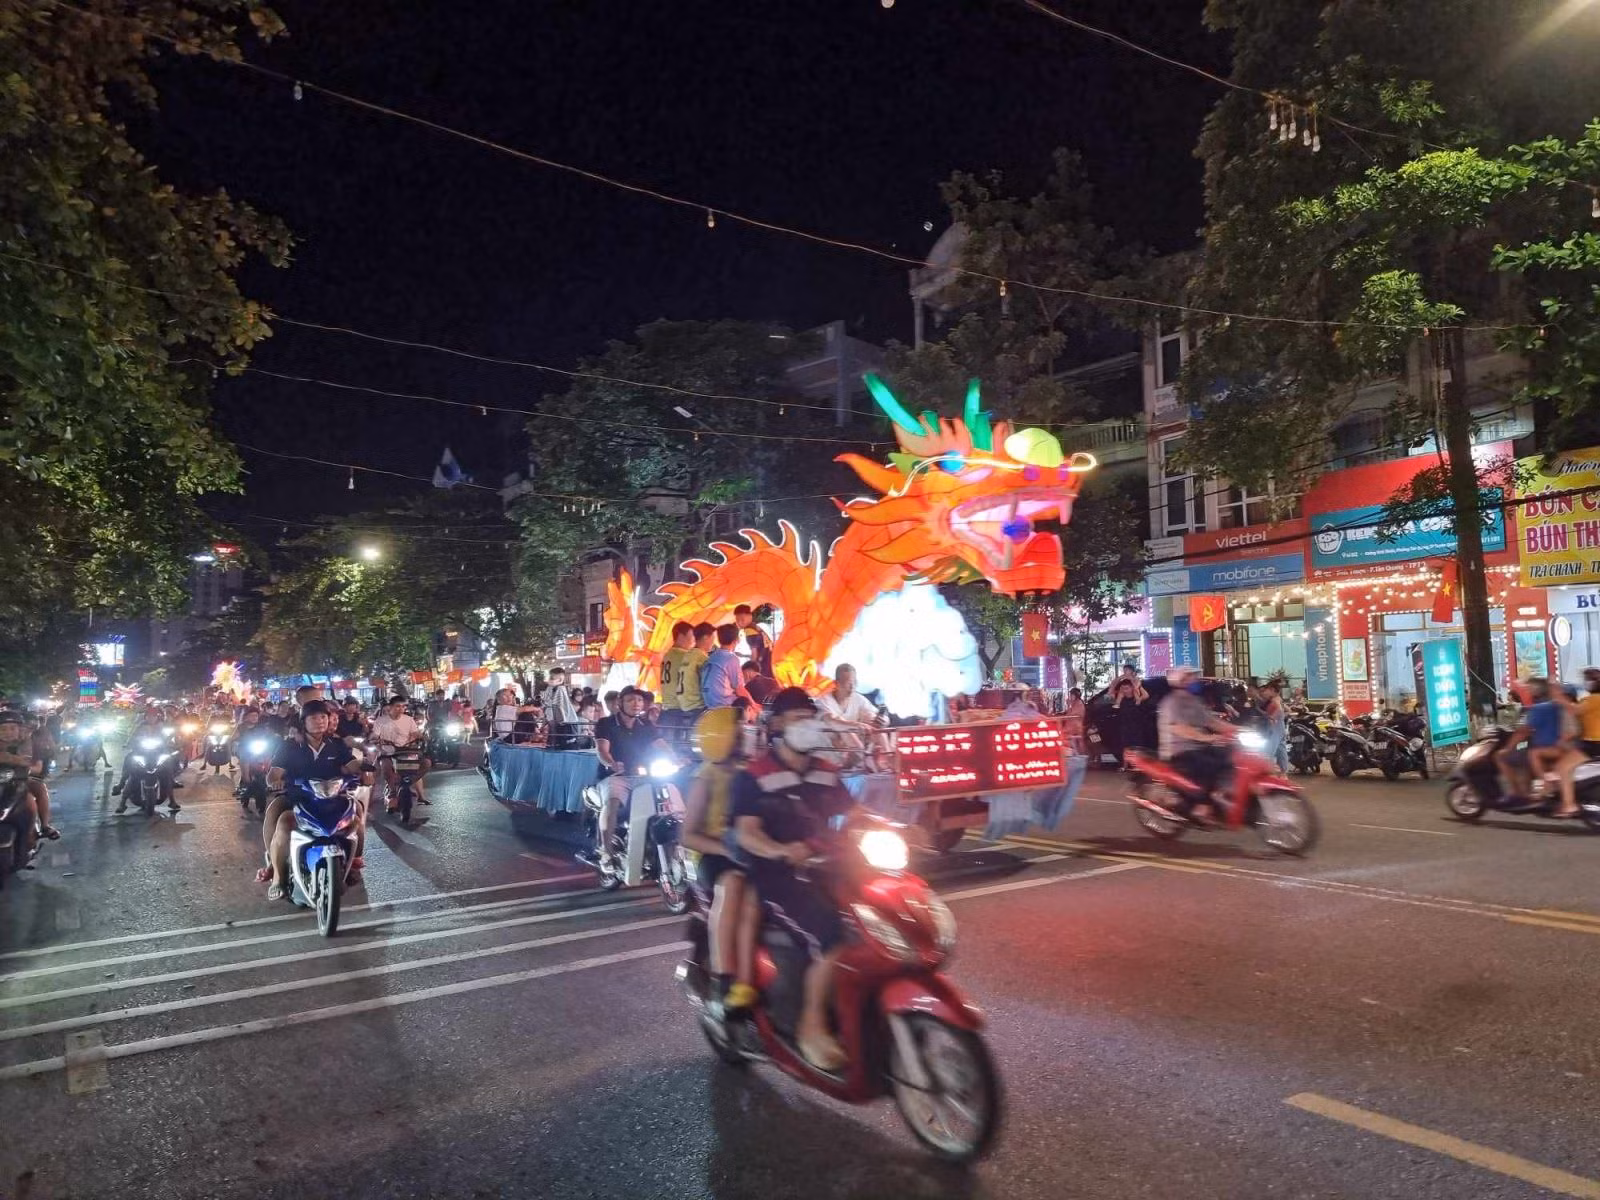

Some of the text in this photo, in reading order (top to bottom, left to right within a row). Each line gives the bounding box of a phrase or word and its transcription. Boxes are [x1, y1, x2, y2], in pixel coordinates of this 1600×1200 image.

[1525, 484, 1574, 518] BÚN
[1581, 491, 1600, 512] C
[1215, 530, 1268, 549] viettel
[1526, 519, 1600, 554] BÚN TH
[1213, 564, 1276, 583] mobifone
